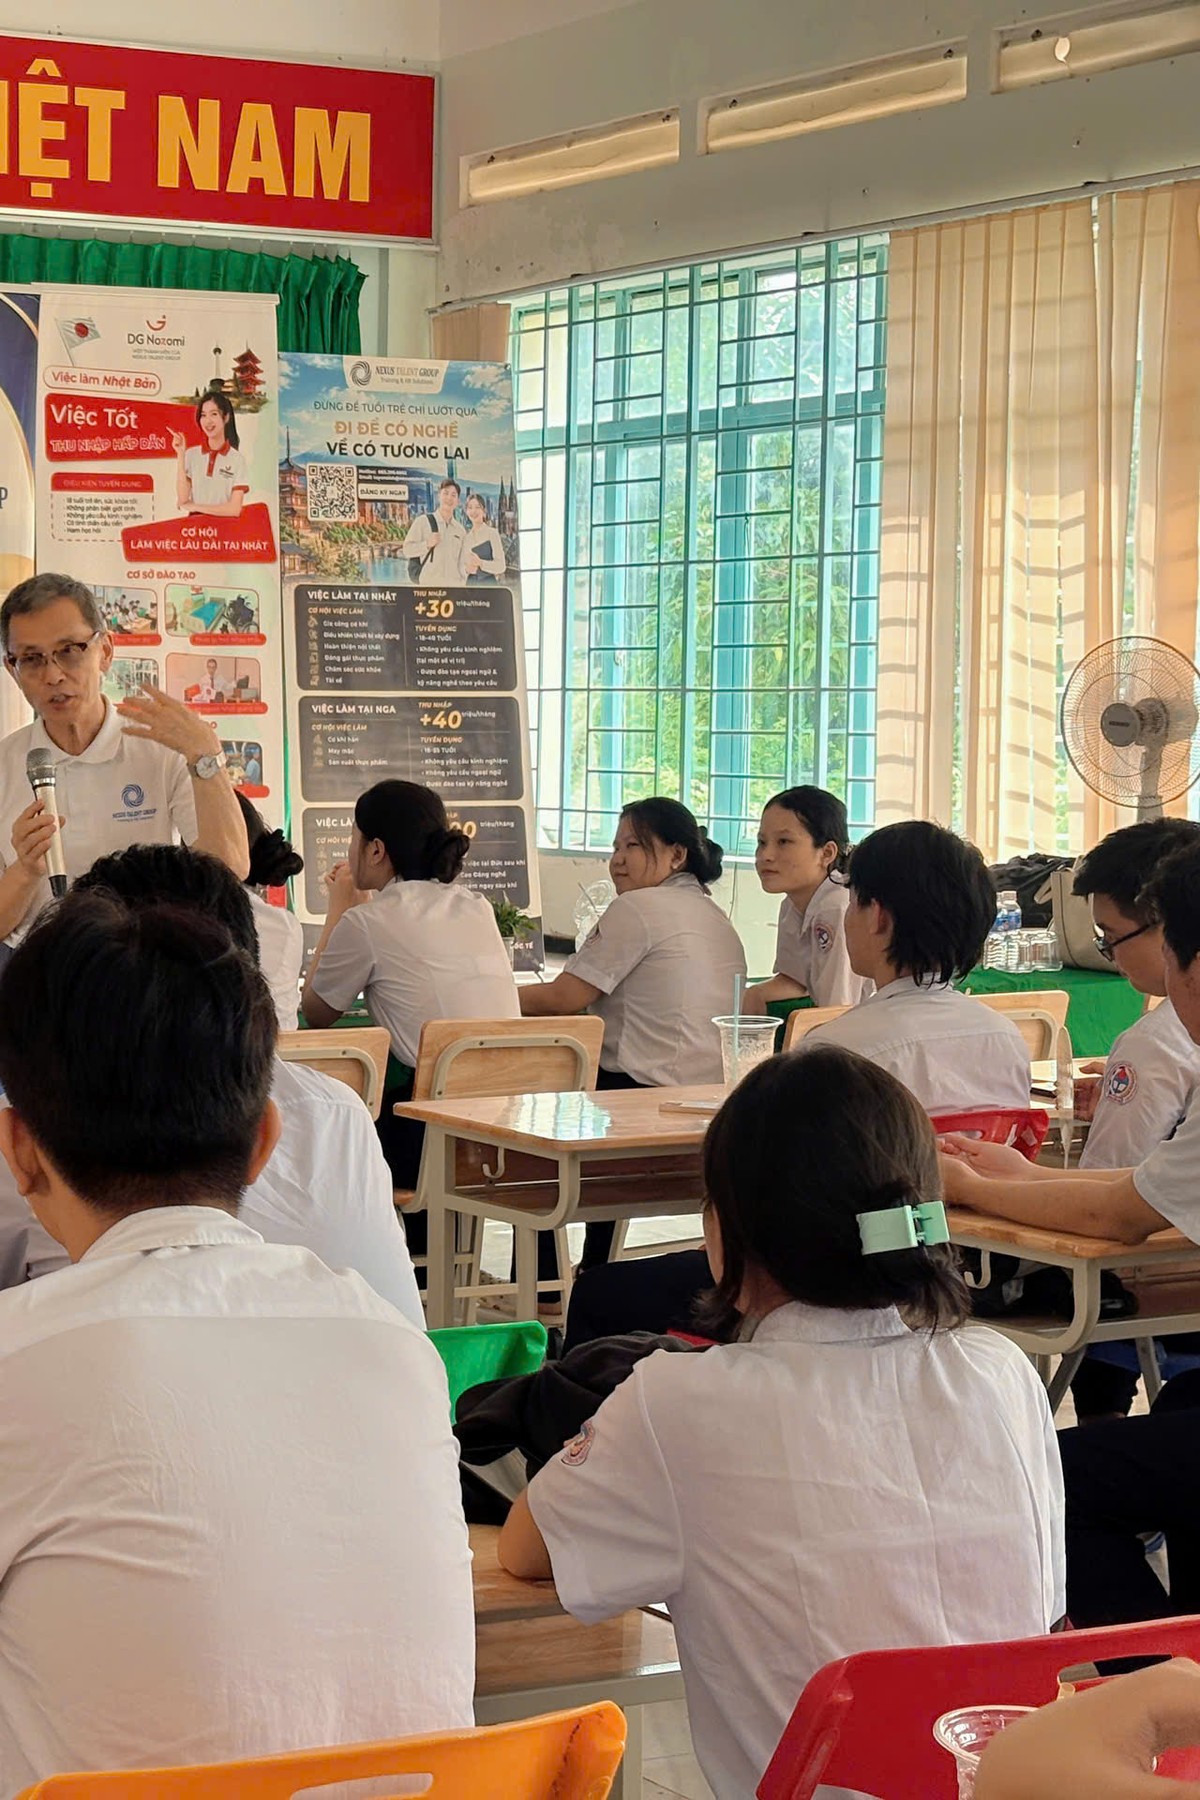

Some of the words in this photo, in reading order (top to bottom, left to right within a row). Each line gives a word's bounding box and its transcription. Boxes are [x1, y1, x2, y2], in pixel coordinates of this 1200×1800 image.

[158, 95, 371, 203] NAM
[127, 333, 144, 345] DG
[147, 334, 185, 346] Nozomi
[52, 370, 77, 383] Việc
[79, 372, 100, 384] làm
[102, 374, 131, 388] Nhật
[134, 375, 156, 389] Bản
[375, 365, 395, 375] NEXUS
[419, 368, 440, 378] GROUP
[50, 404, 98, 430] Việc
[104, 406, 138, 429] Tốt
[455, 408, 478, 418] QUA
[334, 420, 353, 434] ĐI
[385, 419, 408, 437] CÓ
[413, 420, 459, 439] NGHỀ
[50, 439, 77, 452] THU
[326, 437, 348, 457] VỀ
[353, 440, 376, 457] CÓ
[381, 441, 439, 460] TƯƠNG
[444, 446, 470, 460] LAI
[307, 589, 330, 601] VIỆC
[331, 589, 351, 600] LÀM
[353, 592, 369, 603] TẠI
[371, 591, 397, 604] NHẬT
[415, 600, 454, 618] +30
[311, 703, 334, 715] VIỆC
[335, 703, 356, 714] LÀM
[357, 705, 374, 715] TẠI
[375, 705, 397, 714] NGA
[420, 710, 462, 729] +40
